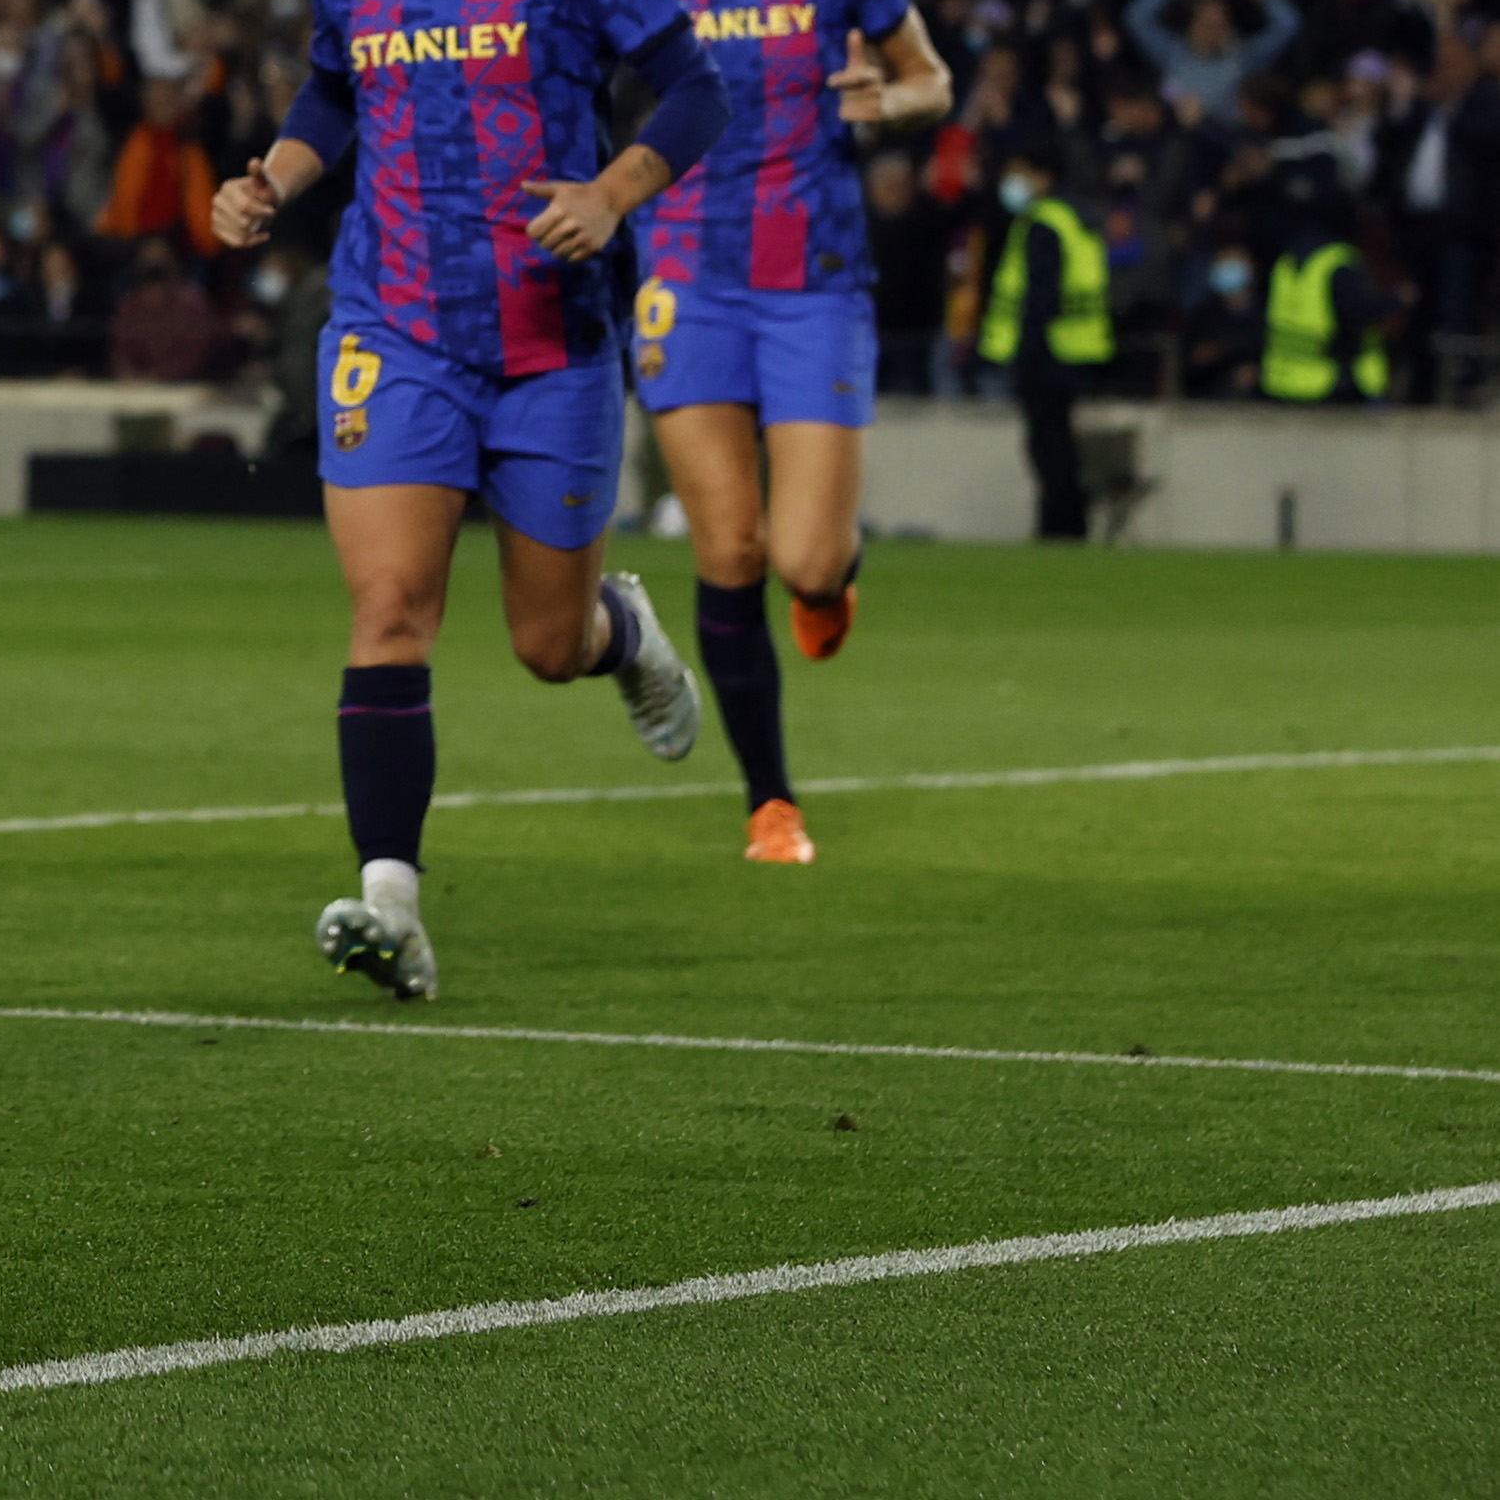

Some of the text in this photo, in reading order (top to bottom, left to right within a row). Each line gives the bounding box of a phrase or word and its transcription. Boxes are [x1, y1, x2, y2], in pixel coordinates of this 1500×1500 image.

[350, 22, 527, 72] STANLEY
[692, 4, 816, 43] ANLEY
[331, 333, 382, 406] 6
